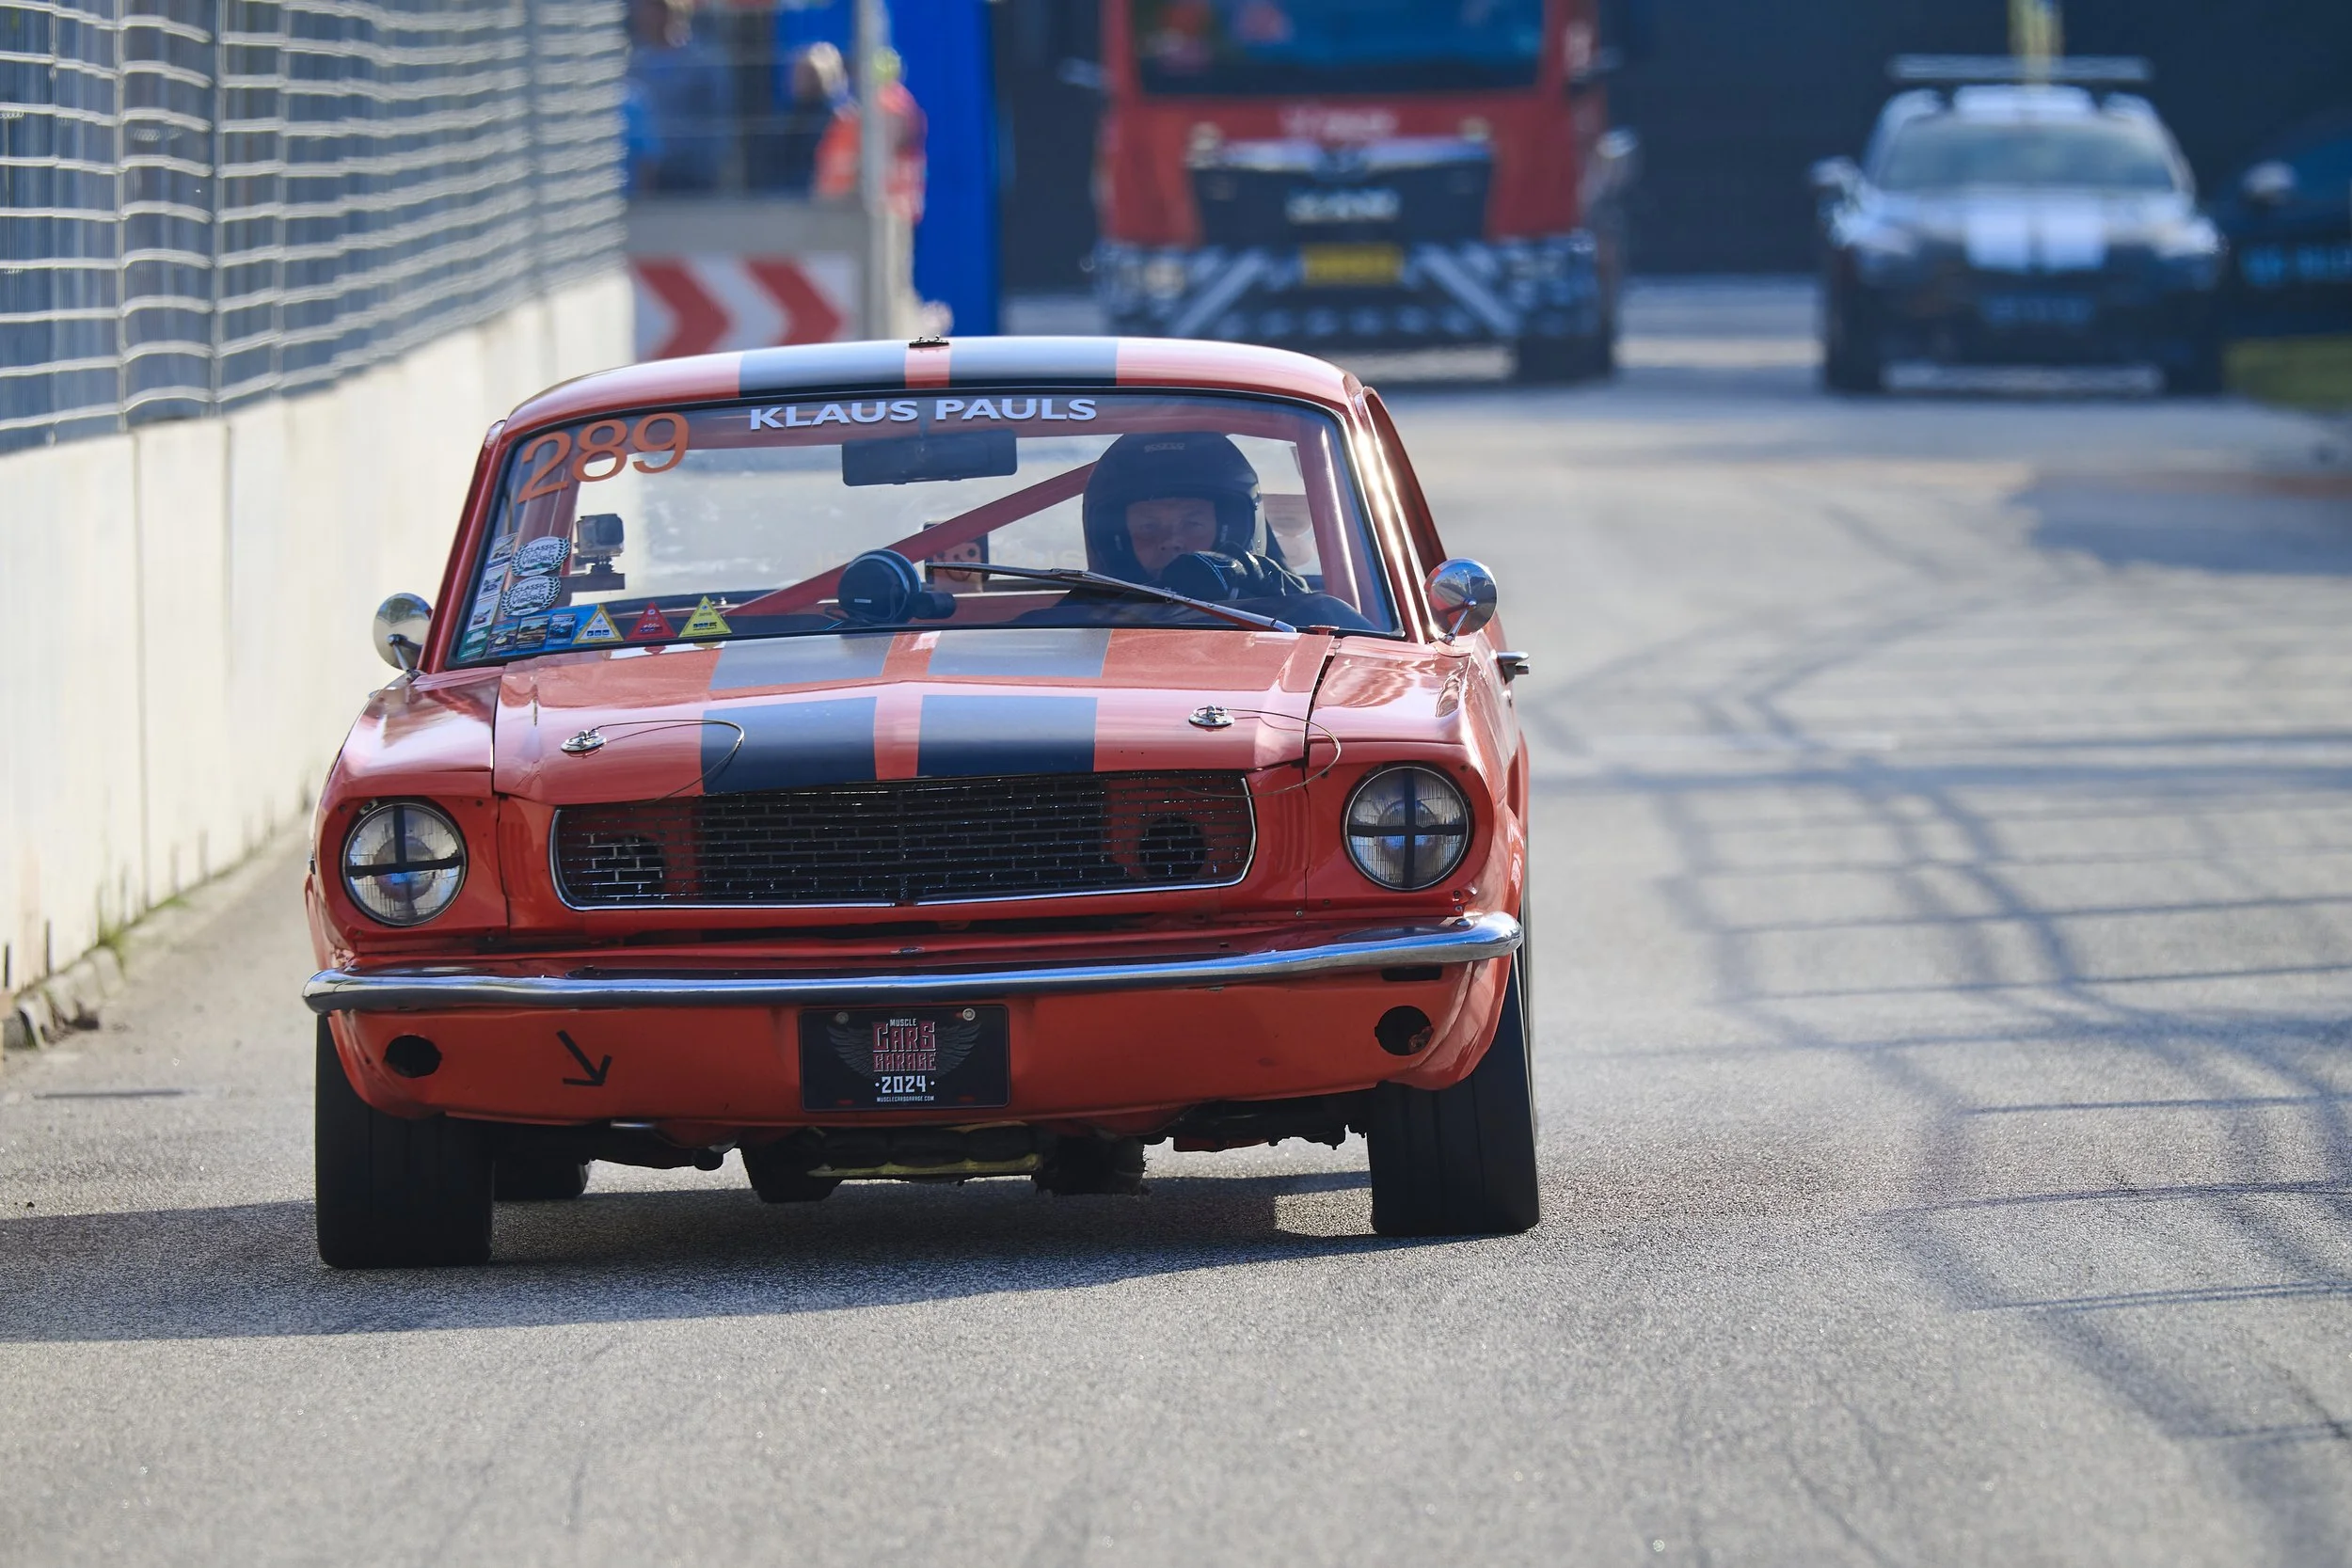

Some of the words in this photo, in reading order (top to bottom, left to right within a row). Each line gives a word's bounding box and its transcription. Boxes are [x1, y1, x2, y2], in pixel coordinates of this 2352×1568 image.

[751, 400, 918, 430] KLAUS
[935, 398, 1098, 421] PAULS
[517, 413, 690, 505] 289
[523, 547, 556, 560] RACE
[527, 543, 558, 552] CLASSIC
[522, 556, 555, 565] VIBORG
[512, 588, 546, 599] RACE
[516, 583, 547, 592] CLASSIC
[512, 594, 546, 604] VIBORG
[890, 1018, 917, 1027] MUSCLE
[873, 1022, 936, 1052] CARS
[873, 1053, 937, 1071] GARAGE
[882, 1075, 927, 1093] 2024
